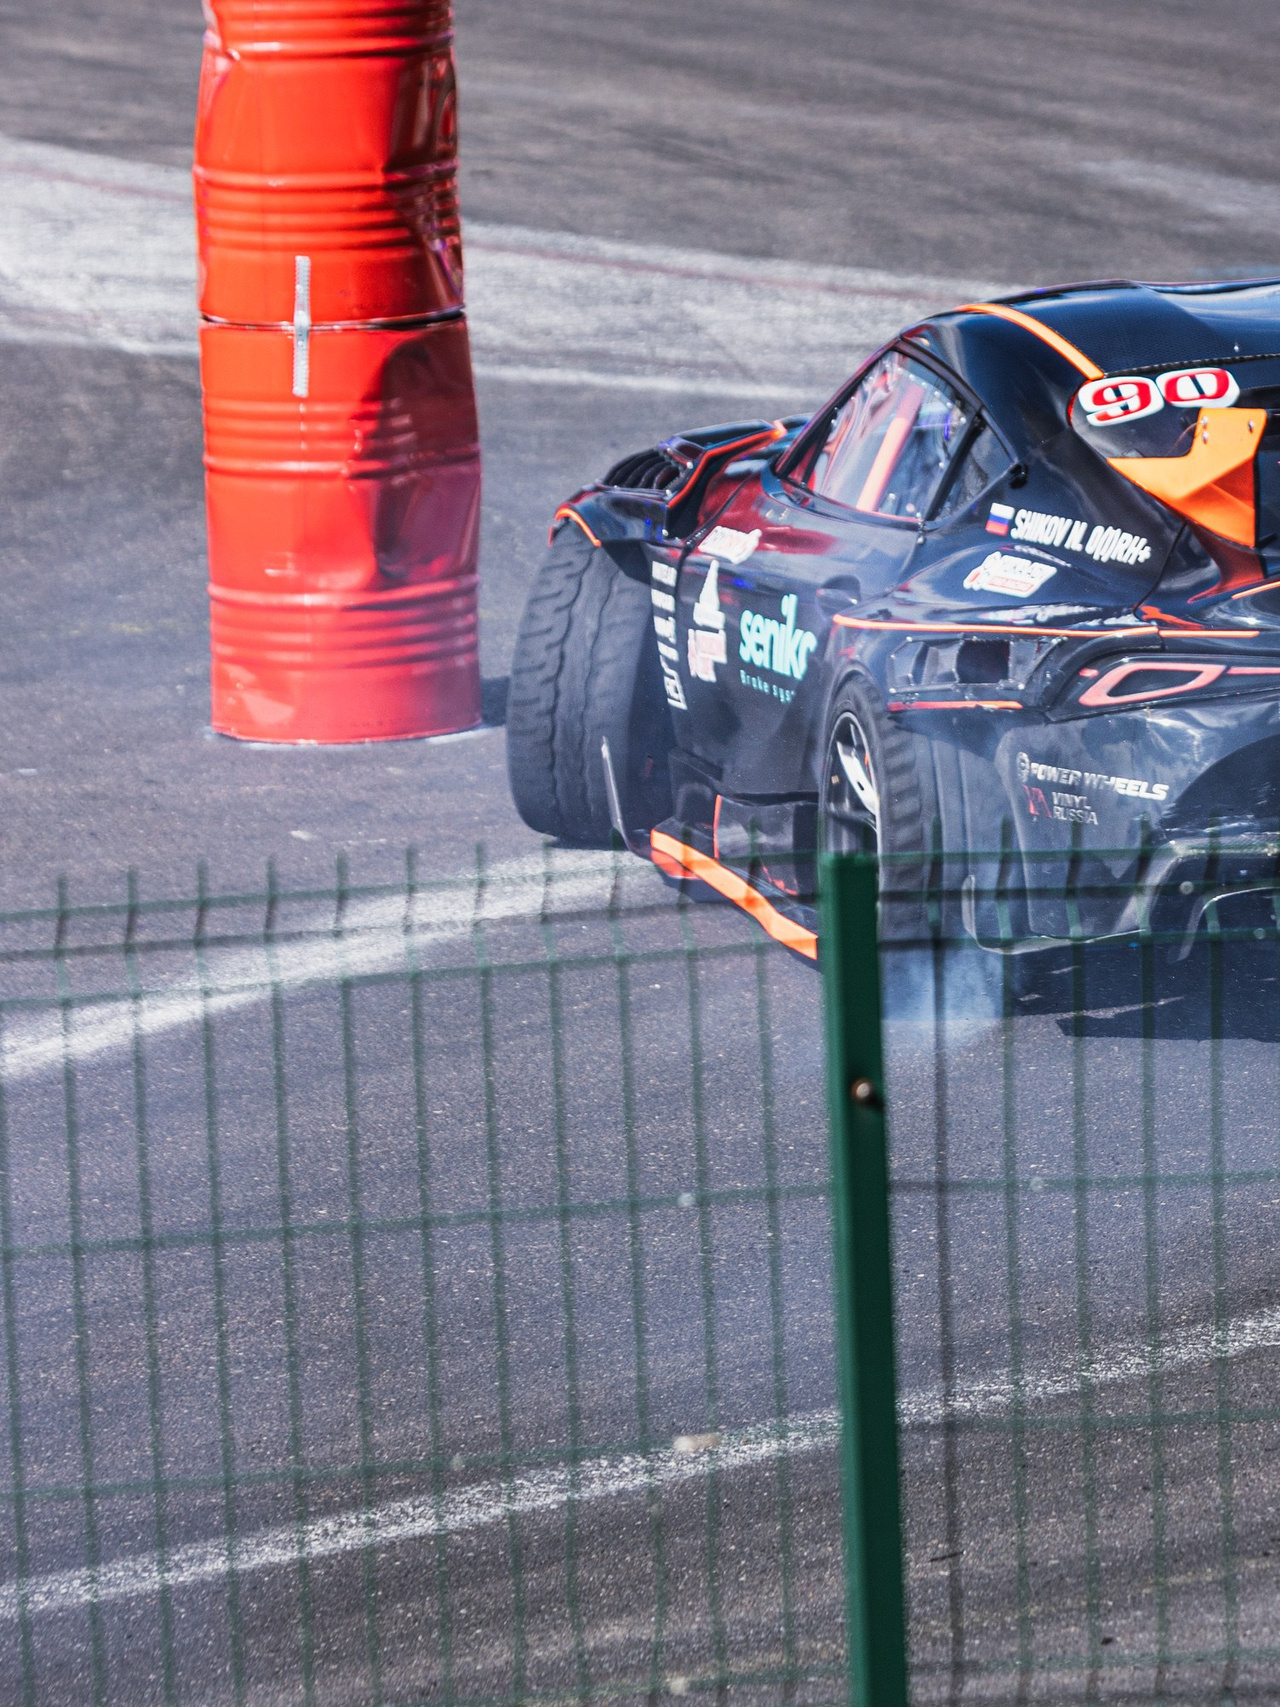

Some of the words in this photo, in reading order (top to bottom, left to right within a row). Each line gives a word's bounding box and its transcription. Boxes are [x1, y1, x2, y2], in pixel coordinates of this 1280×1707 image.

[1079, 367, 1240, 427] 90
[1010, 508, 1073, 547] SHIKOV
[772, 684, 797, 704] sys
[1030, 762, 1083, 786] POWER
[1083, 772, 1170, 801] WHEELS
[1052, 791, 1092, 811] VINYL
